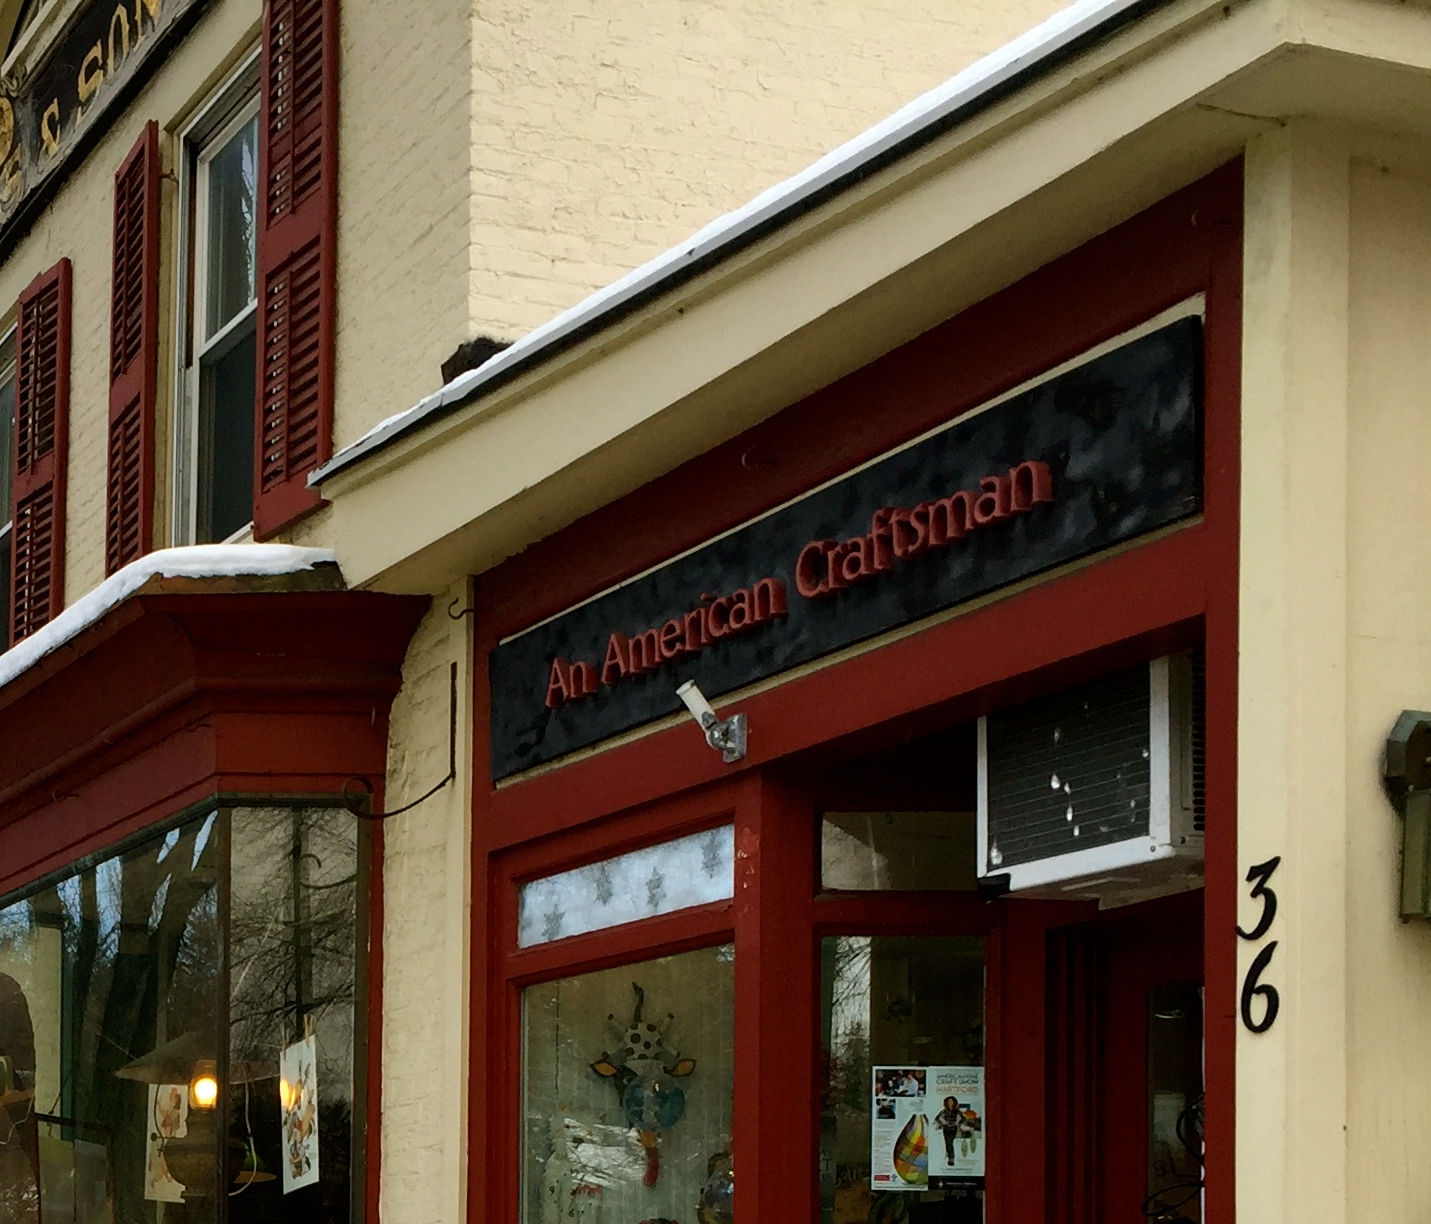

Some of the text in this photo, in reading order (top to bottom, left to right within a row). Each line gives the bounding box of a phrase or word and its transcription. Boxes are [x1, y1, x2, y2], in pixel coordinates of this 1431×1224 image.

[545, 460, 1053, 708] An American Craftsman
